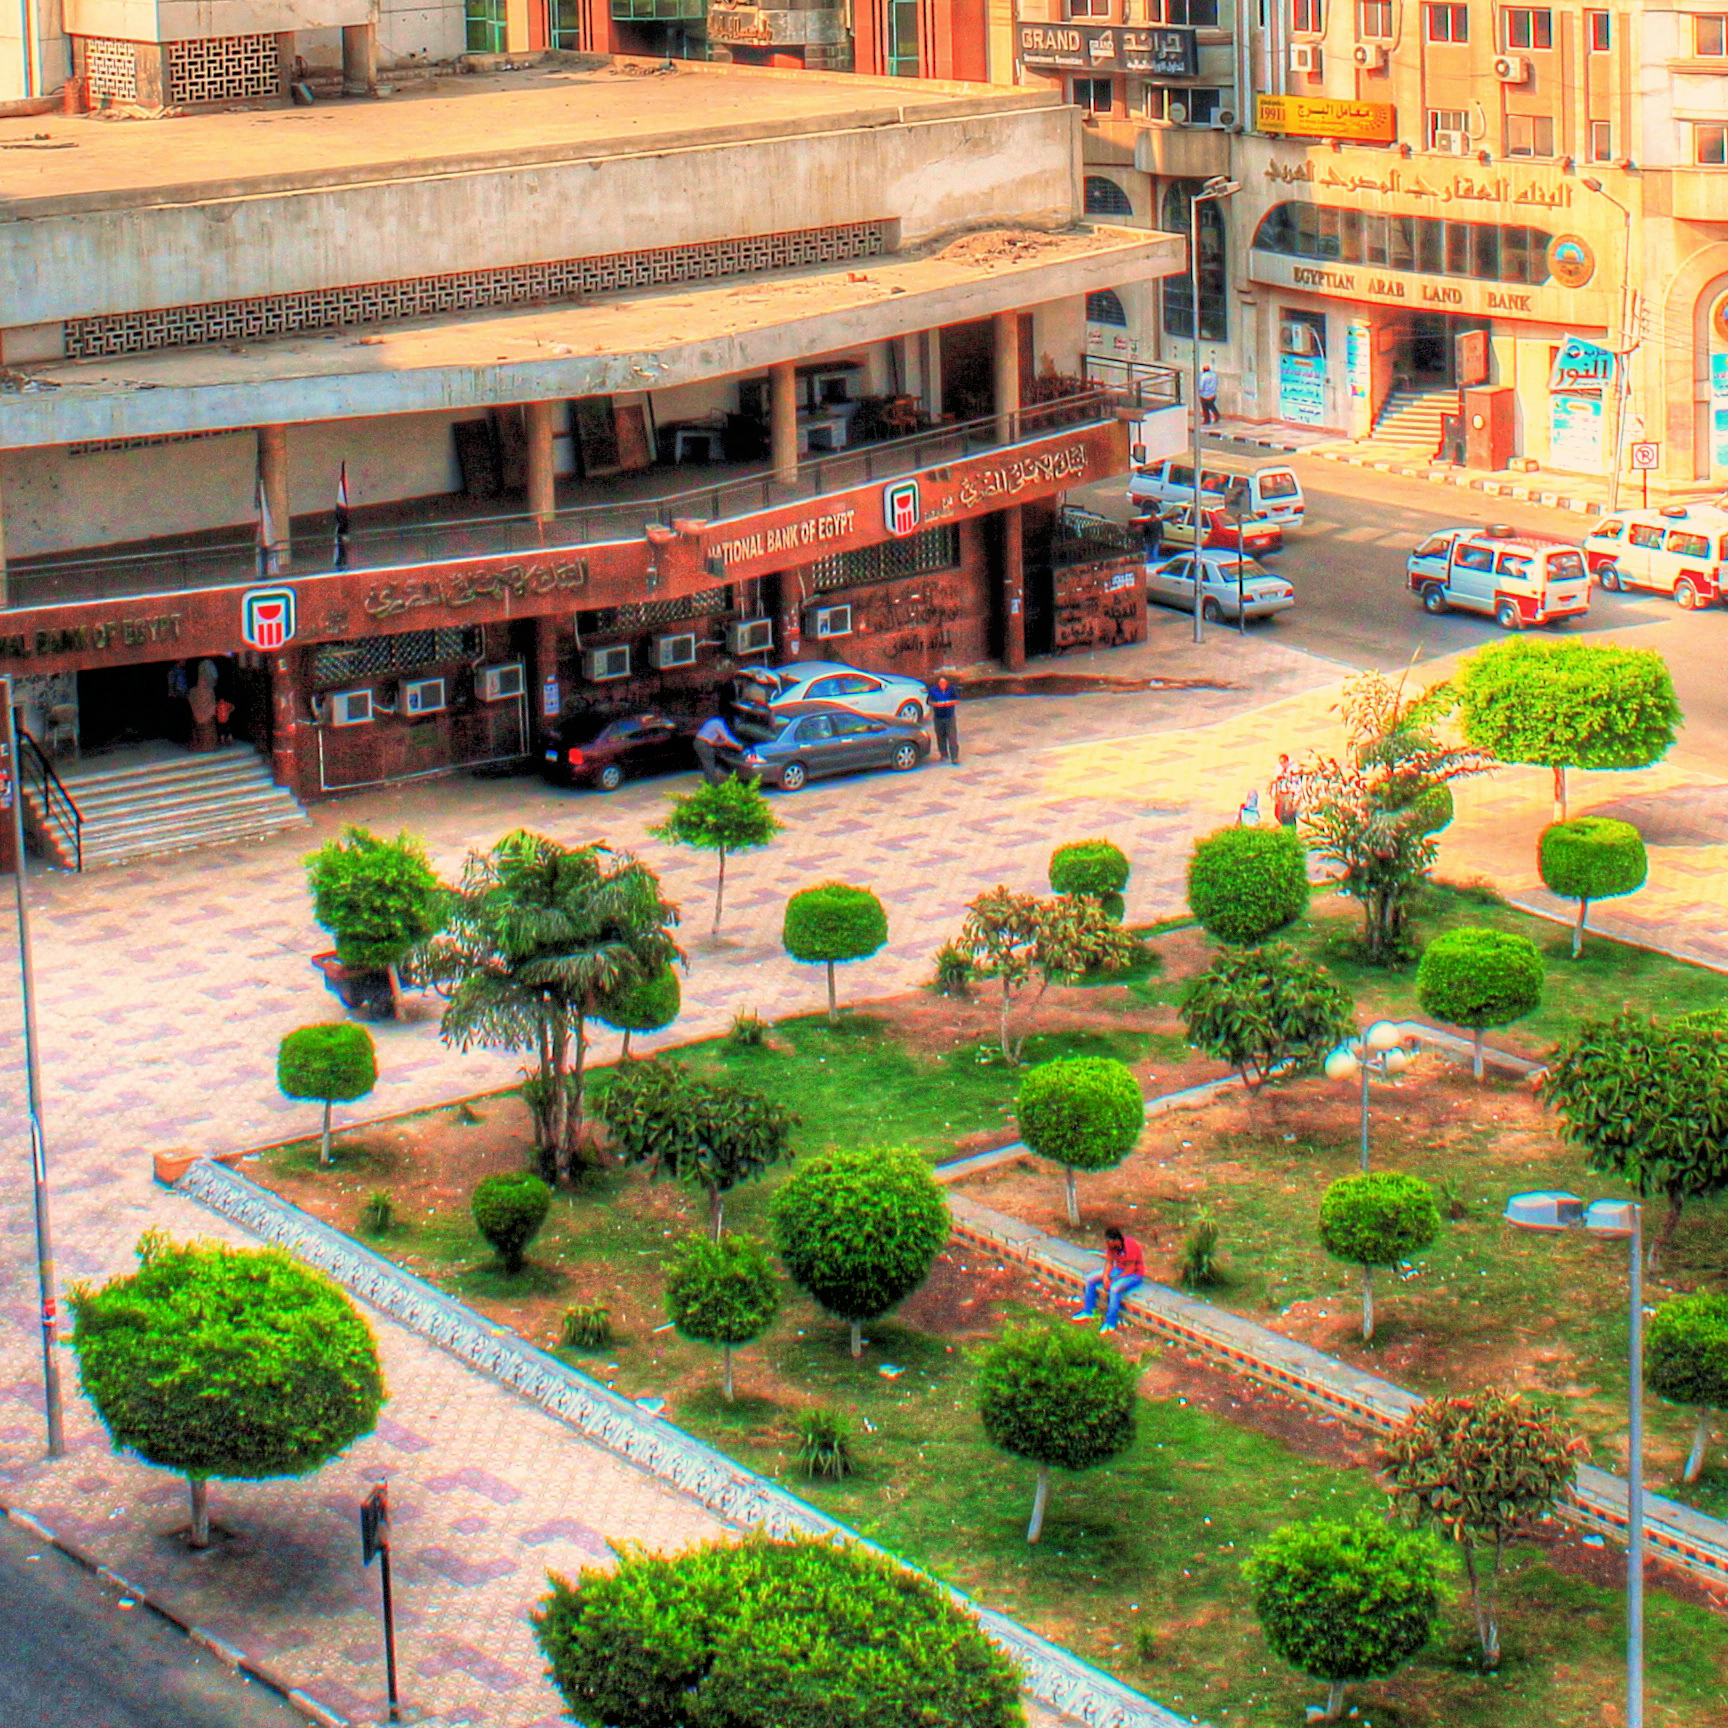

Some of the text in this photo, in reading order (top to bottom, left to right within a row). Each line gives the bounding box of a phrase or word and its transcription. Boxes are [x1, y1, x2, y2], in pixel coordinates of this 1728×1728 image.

[1021, 28, 1081, 52] GRAND
[1123, 32, 1183, 59] جراند
[1293, 266, 1532, 312] EGYPTIAN ARAB LAND BANK
[1555, 359, 1608, 387] النور
[767, 524, 799, 554] BANK
[801, 518, 818, 543] OF
[818, 509, 855, 540] EGYPT
[35, 624, 88, 654] BANK
[94, 622, 117, 649] OF
[122, 614, 182, 645] EGYPT
